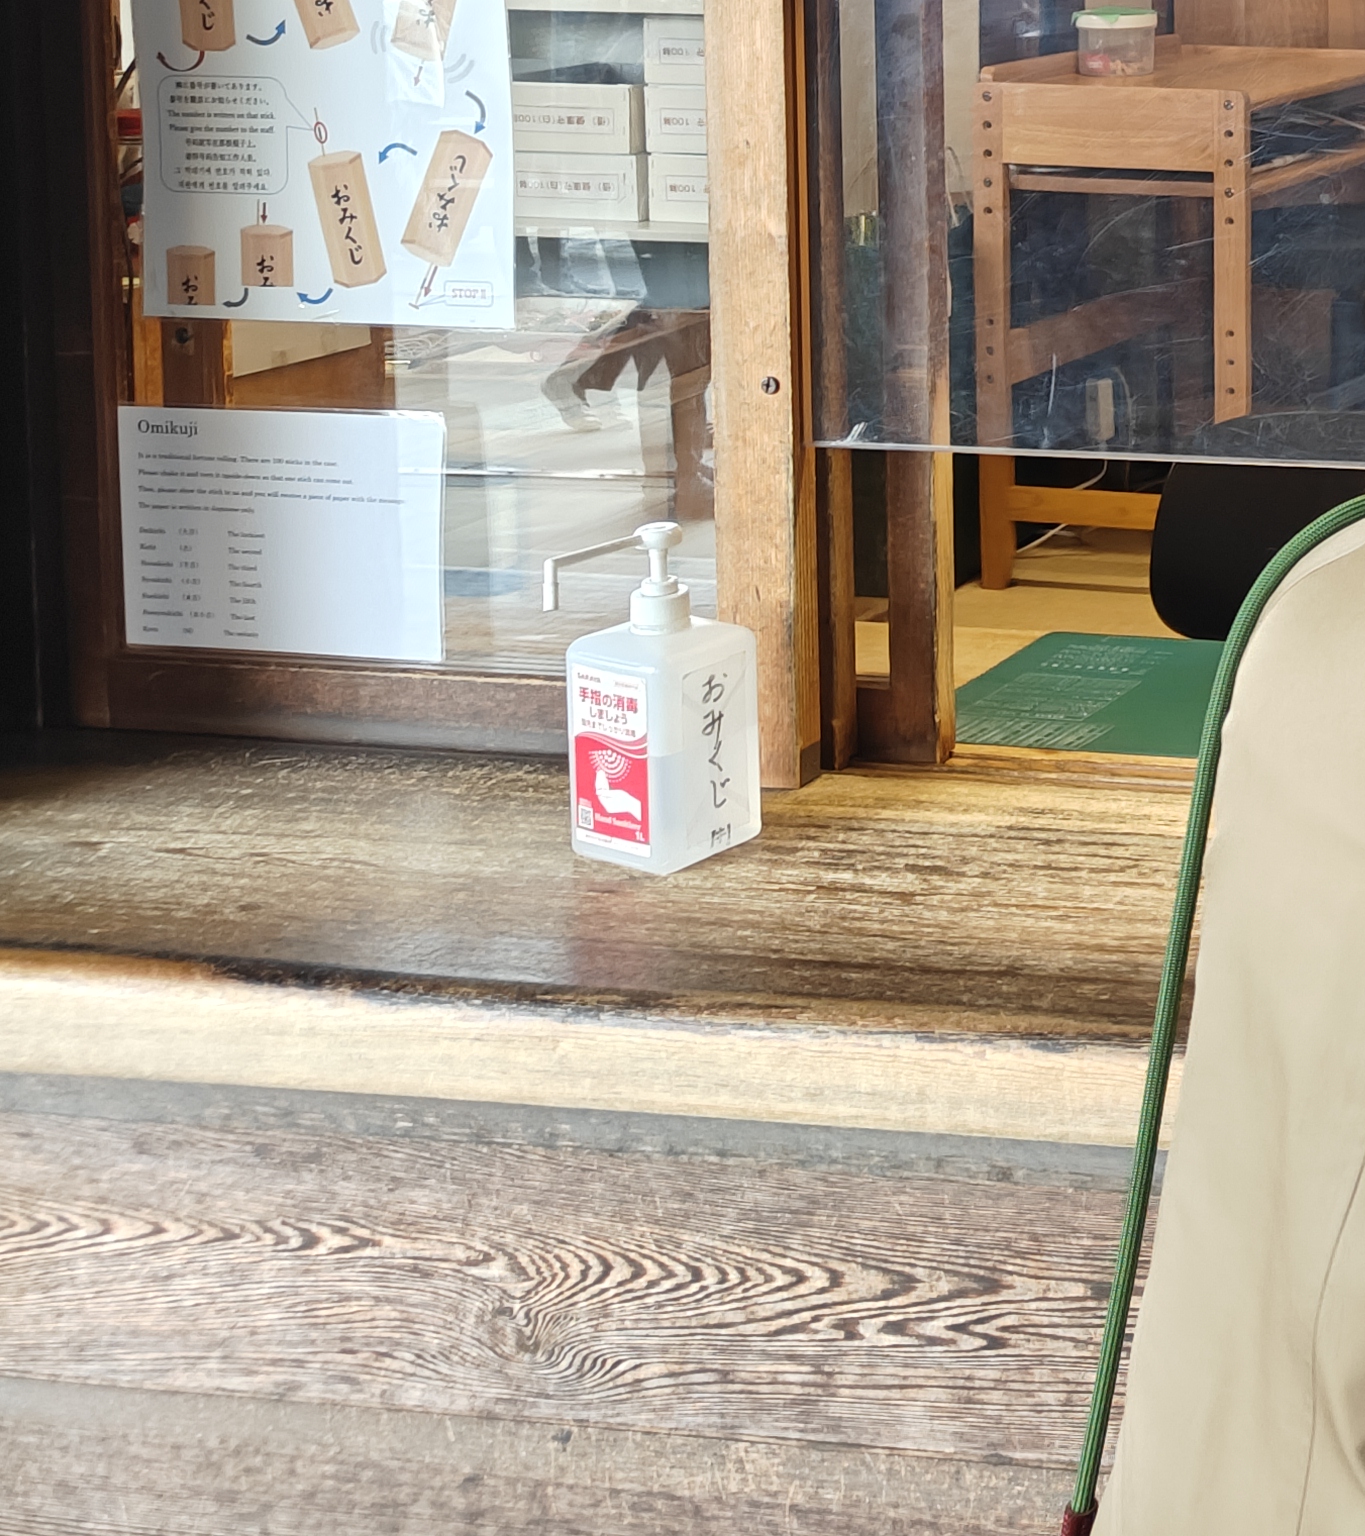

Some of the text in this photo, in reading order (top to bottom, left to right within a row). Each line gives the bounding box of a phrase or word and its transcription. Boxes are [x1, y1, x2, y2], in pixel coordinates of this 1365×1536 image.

[331, 184, 363, 266] おみくじ
[138, 419, 198, 438] Omikuji
[579, 686, 638, 714] 手指の消毒
[589, 706, 628, 725] しましょう
